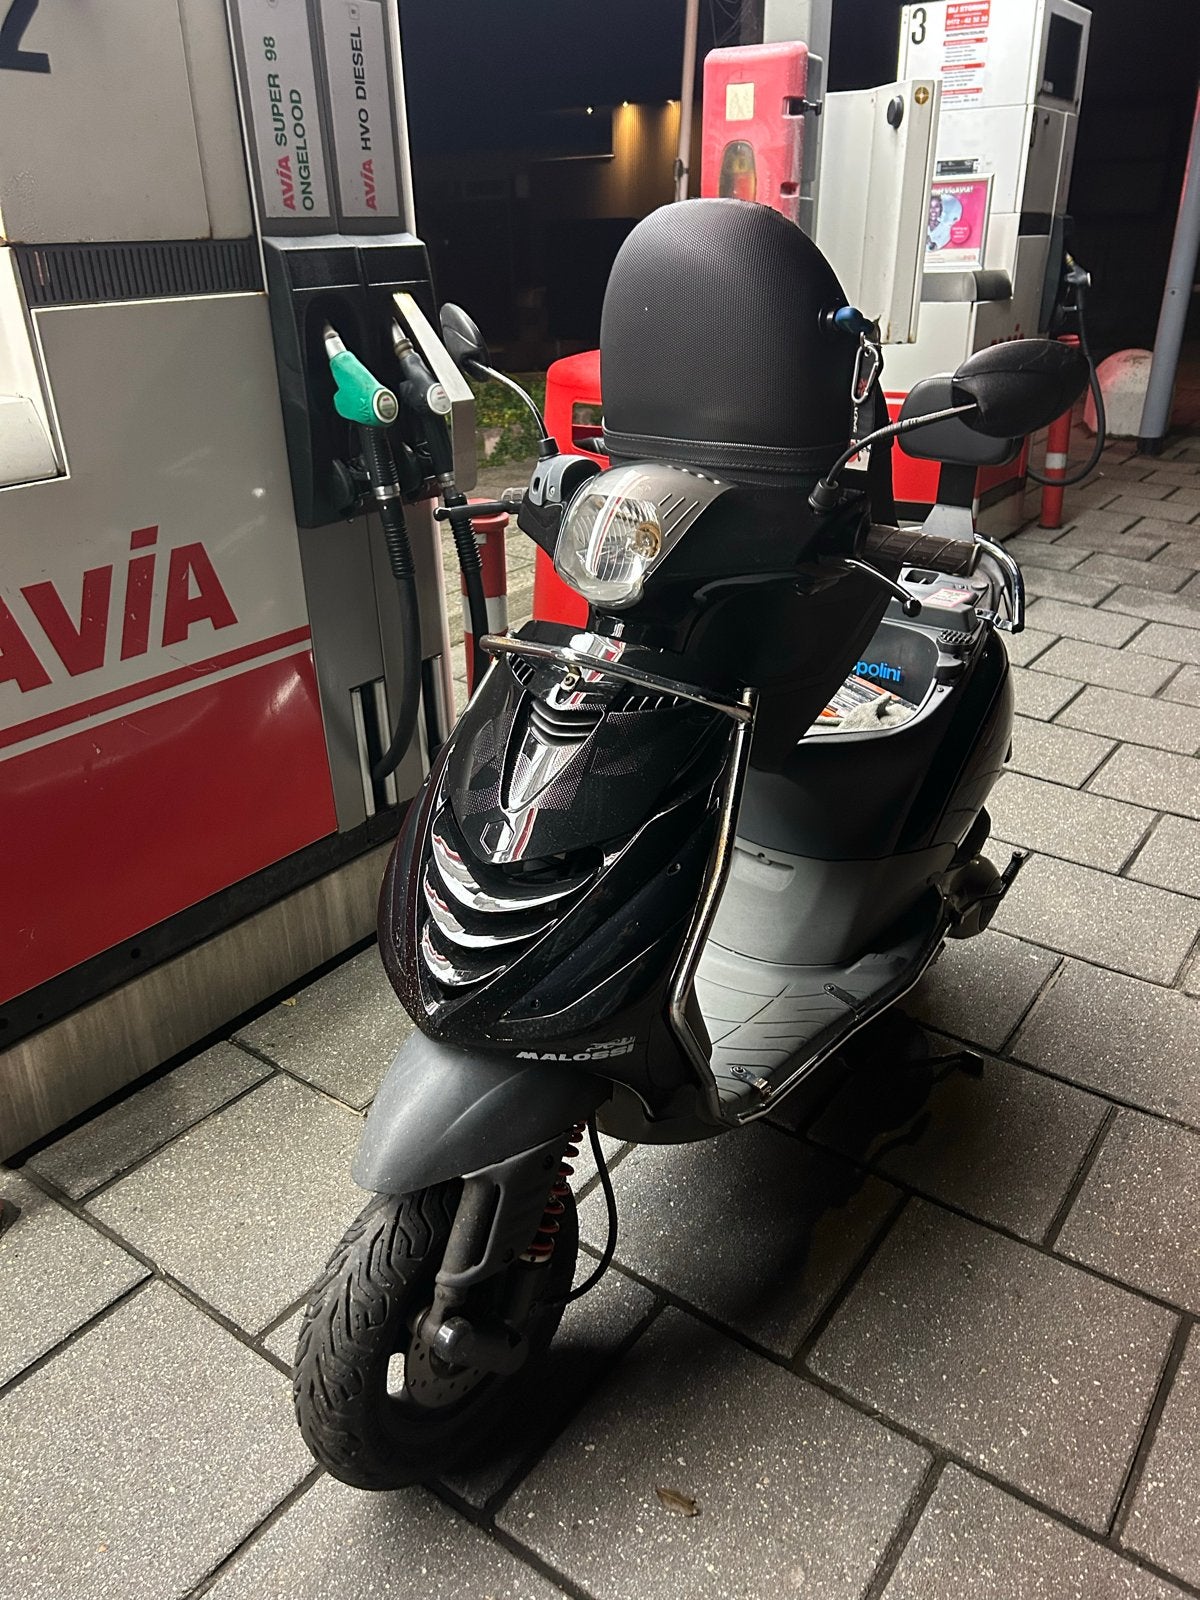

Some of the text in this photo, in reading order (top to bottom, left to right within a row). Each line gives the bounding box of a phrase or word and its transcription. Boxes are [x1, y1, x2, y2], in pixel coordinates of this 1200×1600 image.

[912, 7, 927, 44] 3
[263, 36, 296, 211] AVIA SUPER 98
[290, 89, 314, 211] ONGELOOD
[351, 26, 378, 211] AVIA HVO DIESEL
[855, 661, 902, 682] polini
[516, 1043, 634, 1061] MALOSSI
